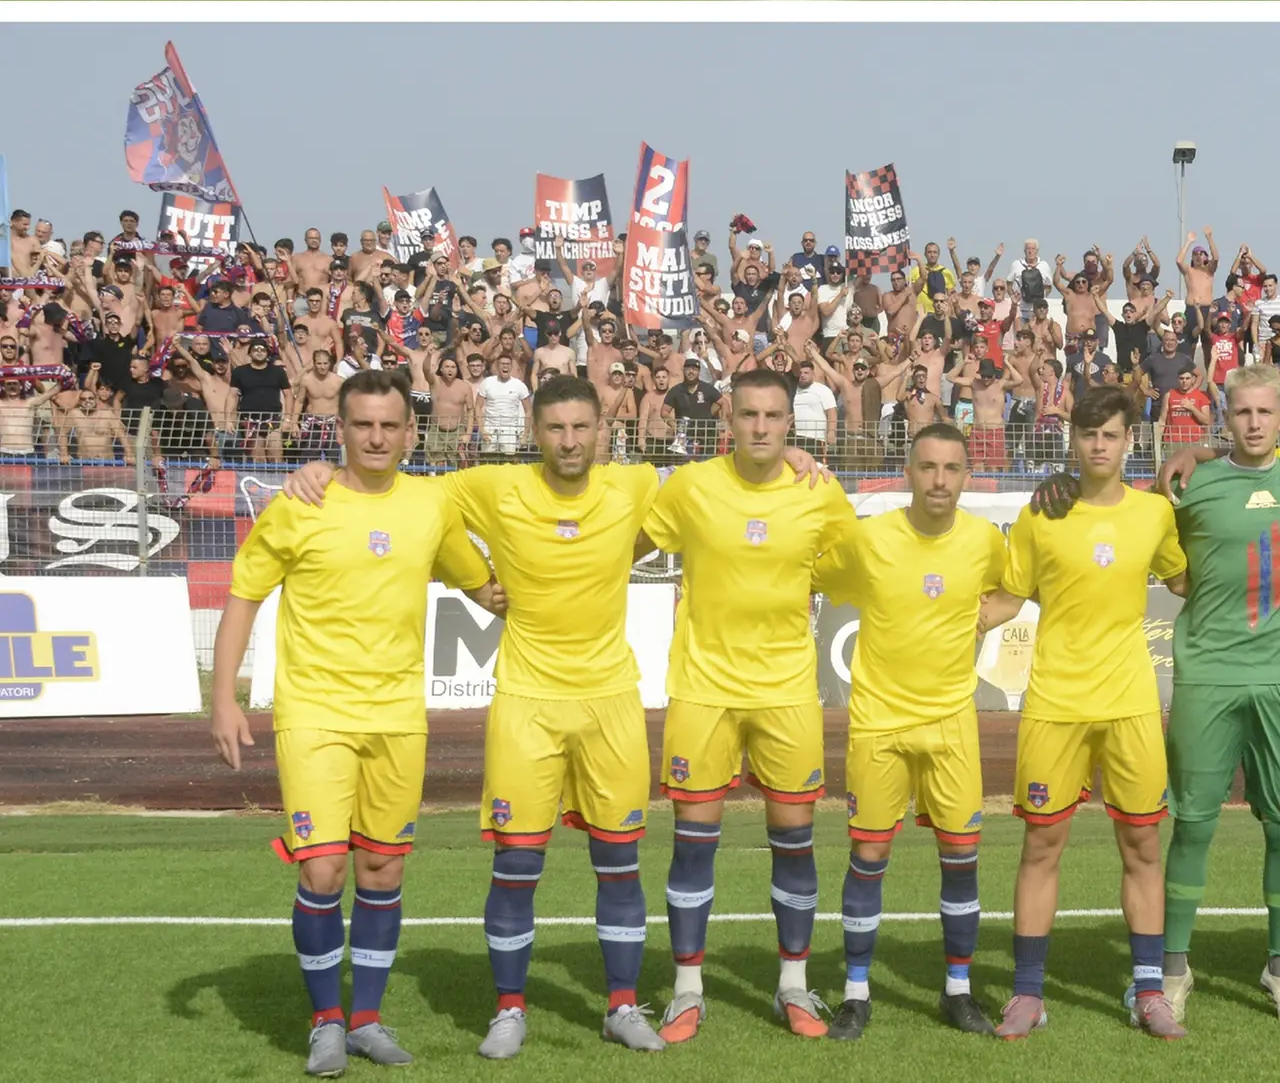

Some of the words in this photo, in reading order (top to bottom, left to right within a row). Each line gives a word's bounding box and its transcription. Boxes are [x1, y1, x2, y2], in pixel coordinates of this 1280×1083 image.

[643, 165, 675, 215] 2
[545, 200, 602, 222] TIMP
[540, 221, 591, 240] RUSS
[597, 220, 609, 238] E
[637, 242, 686, 272] MAI
[629, 266, 690, 297] SUTT
[629, 292, 639, 311] A
[1002, 627, 1030, 642] CALA
